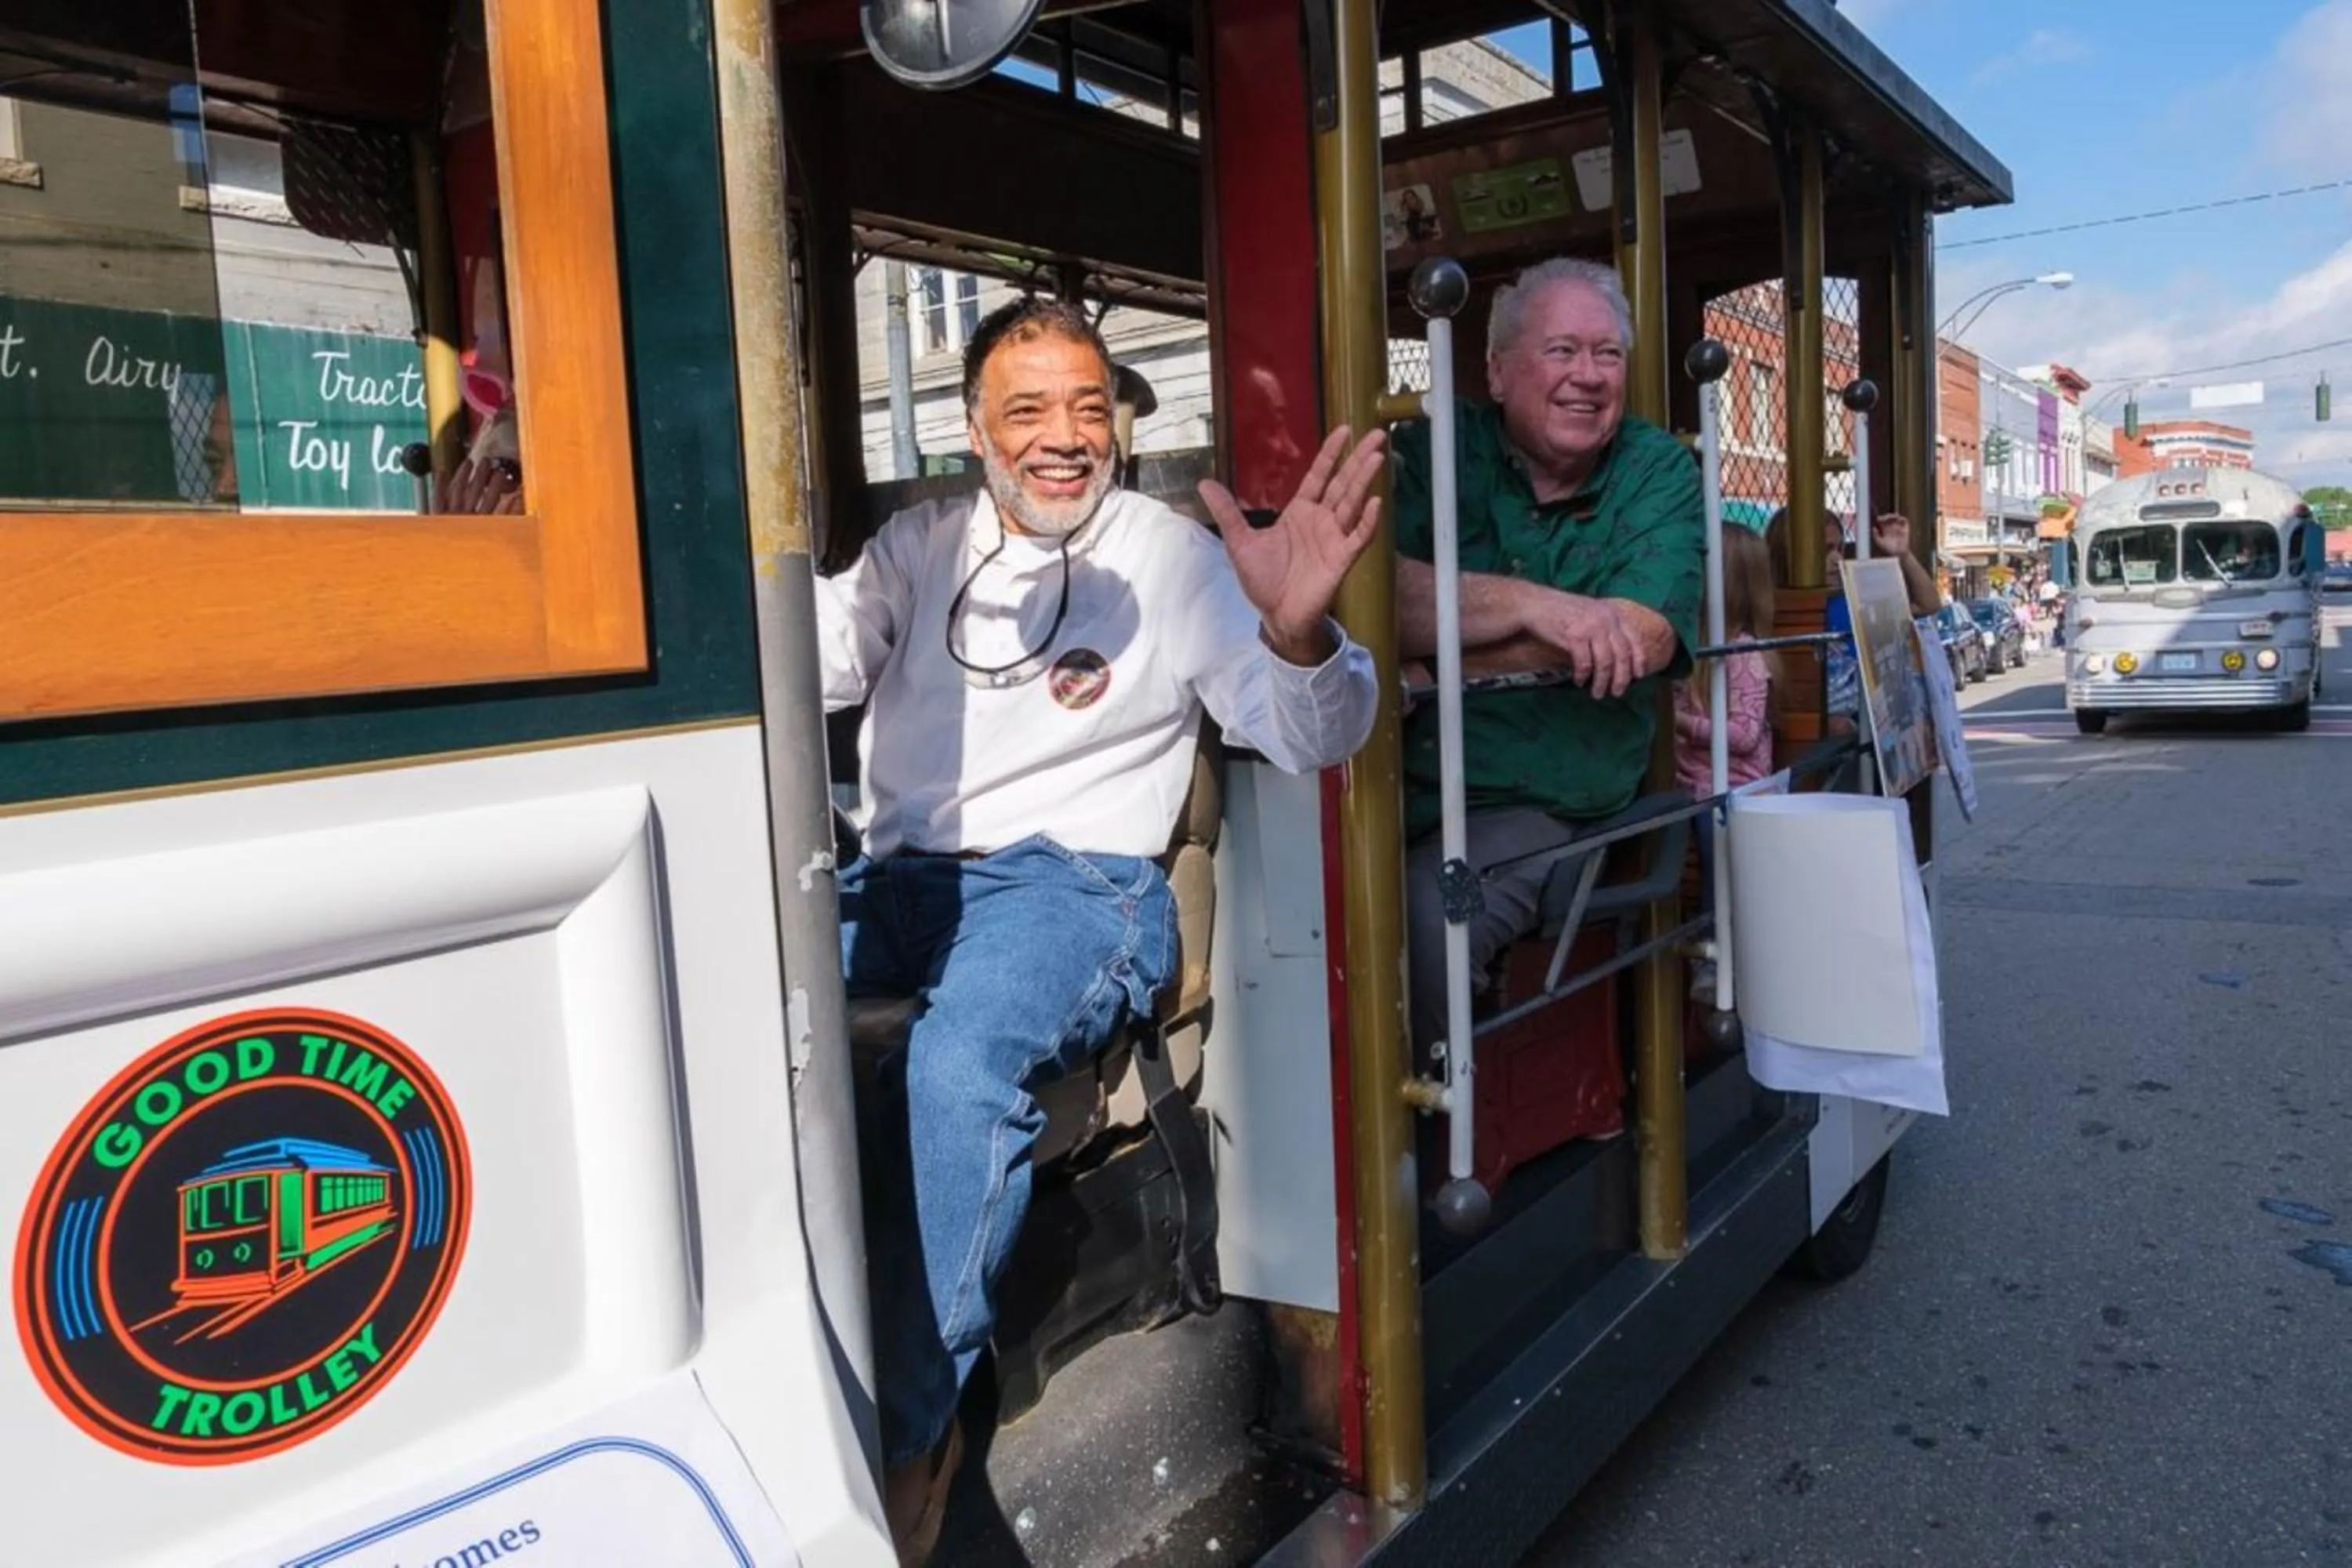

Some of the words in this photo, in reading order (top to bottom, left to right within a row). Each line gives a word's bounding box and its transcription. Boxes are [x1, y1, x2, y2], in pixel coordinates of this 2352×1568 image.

[85, 336, 181, 406] Airy
[278, 420, 350, 492] Toy
[93, 1037, 274, 1168] GOOD
[299, 1034, 416, 1120] TIME
[151, 1322, 381, 1436] TROLLEY
